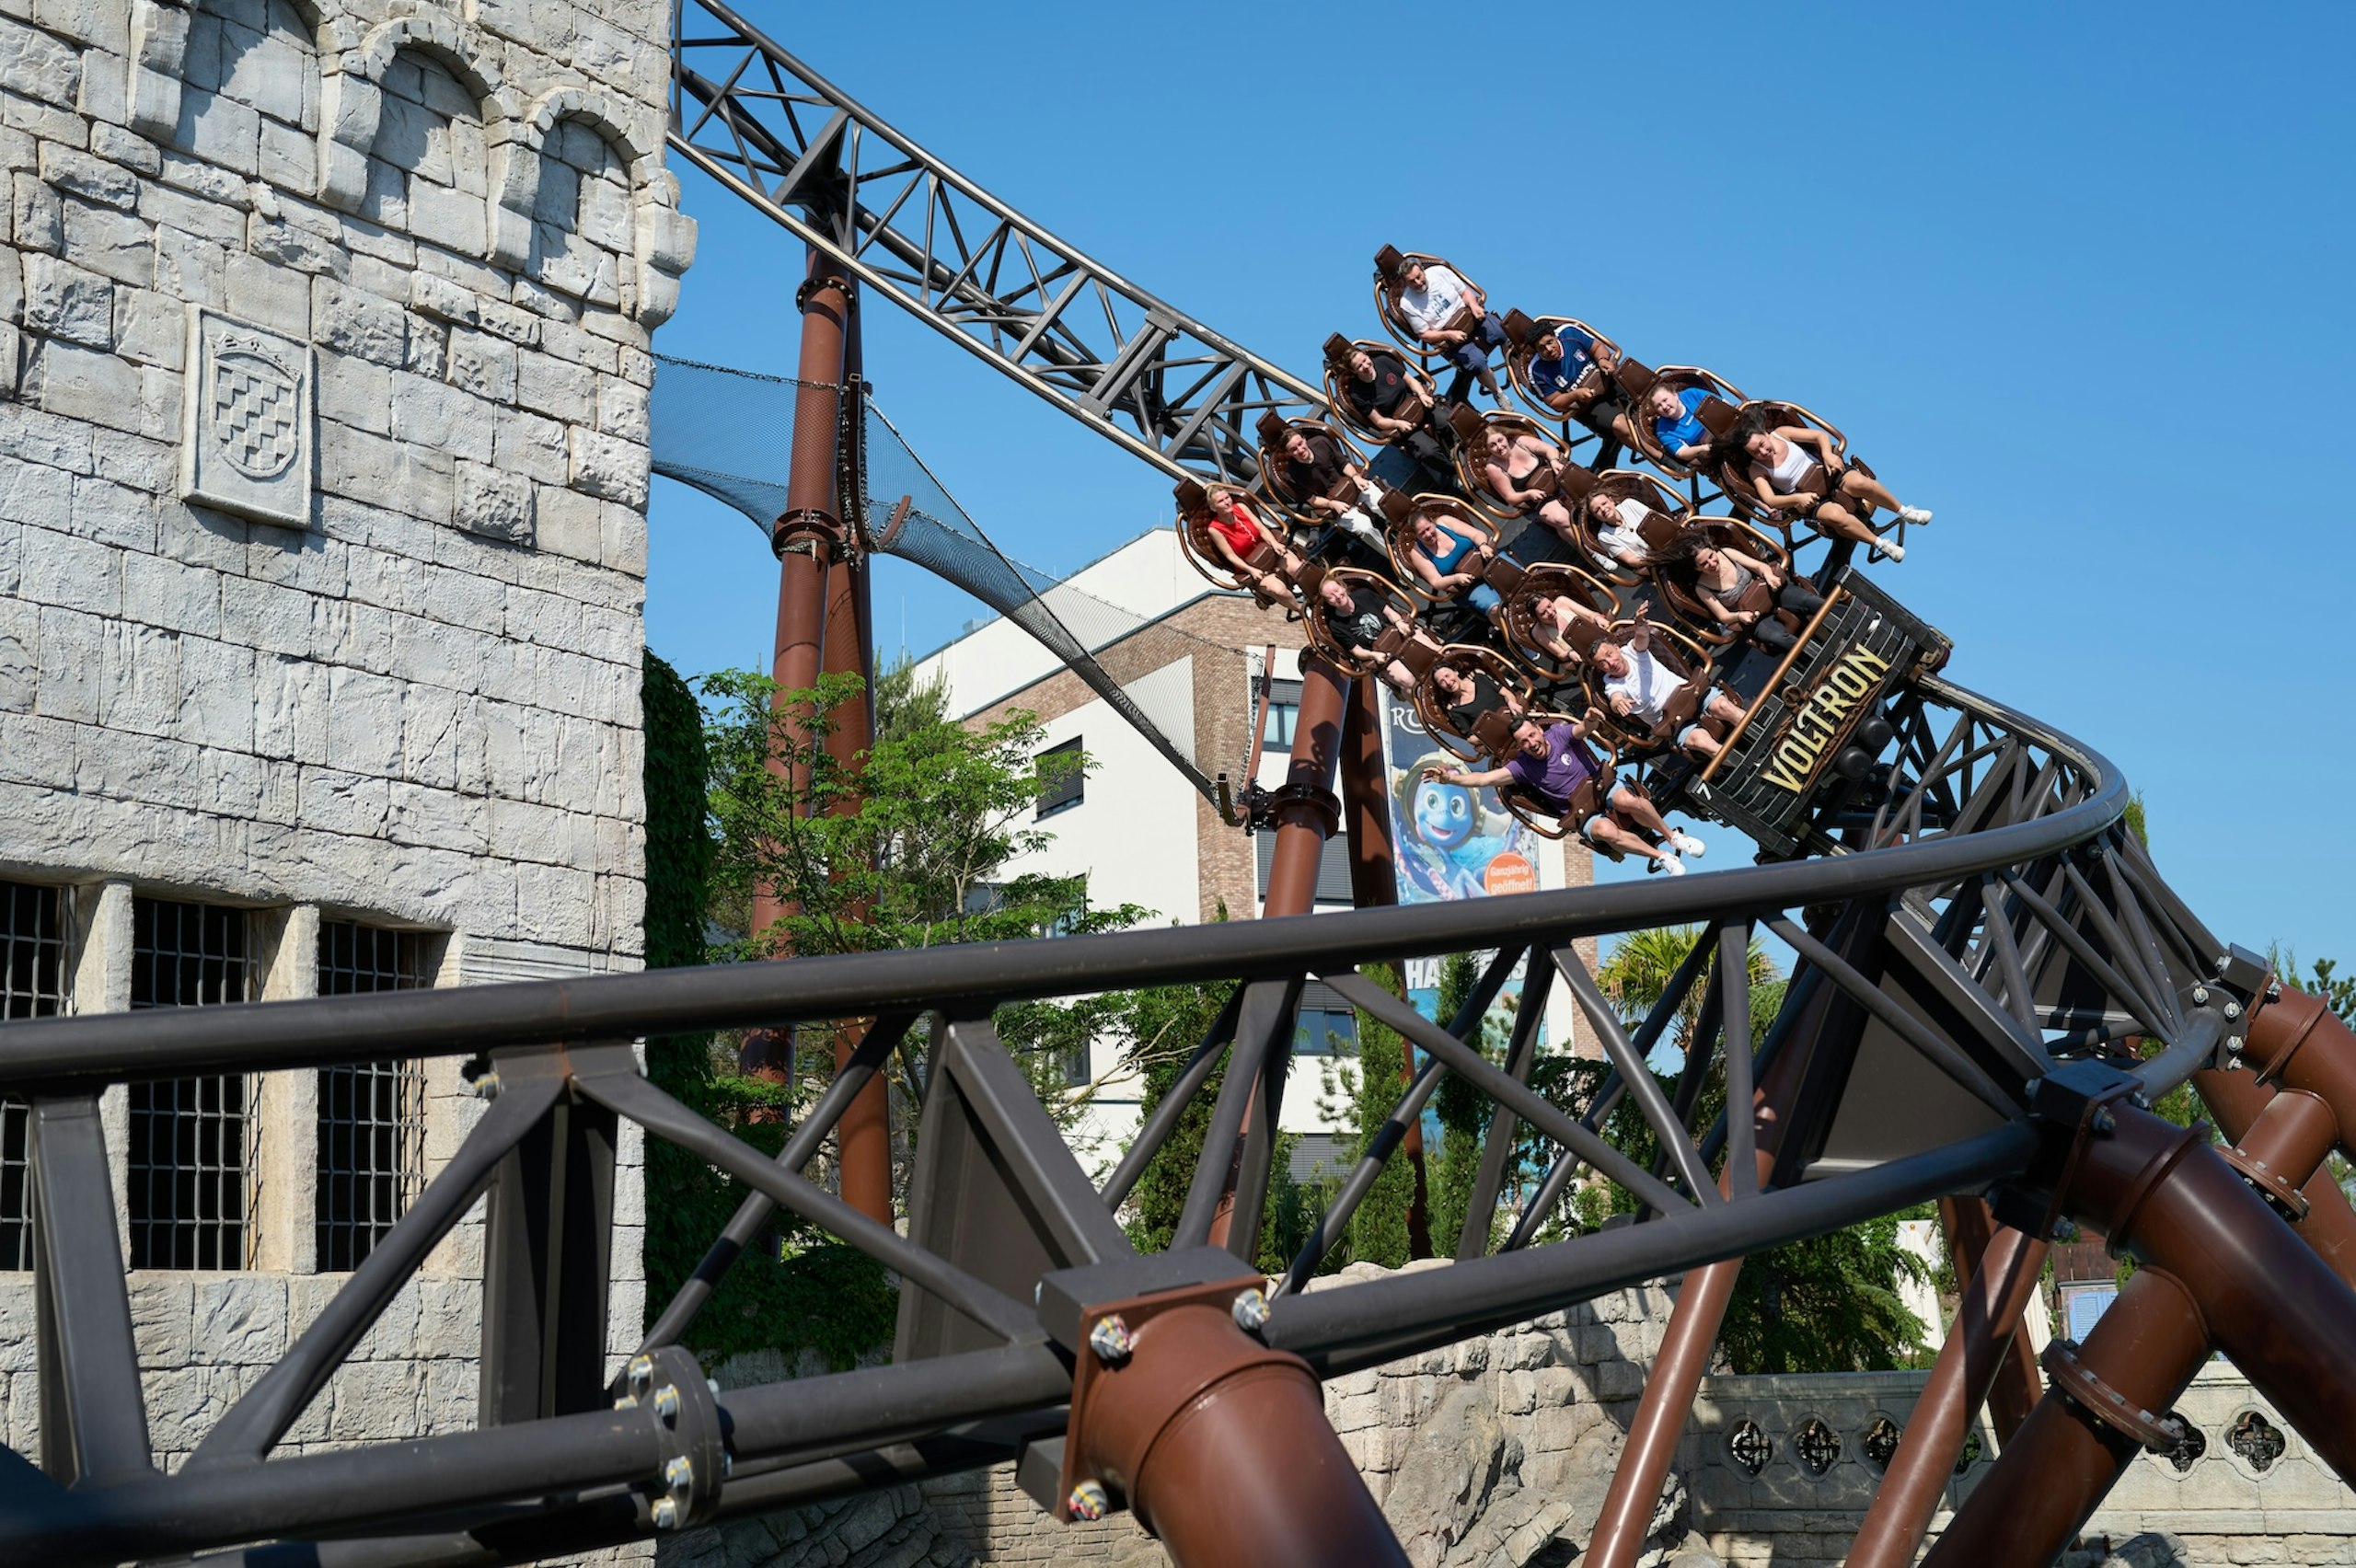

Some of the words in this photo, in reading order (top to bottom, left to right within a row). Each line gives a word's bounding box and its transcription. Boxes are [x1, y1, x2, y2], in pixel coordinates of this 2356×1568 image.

[1761, 643, 1890, 794] VOLTRON
[1490, 864, 1529, 877] Ganzjährig
[1491, 878, 1533, 895] geöffnet!
